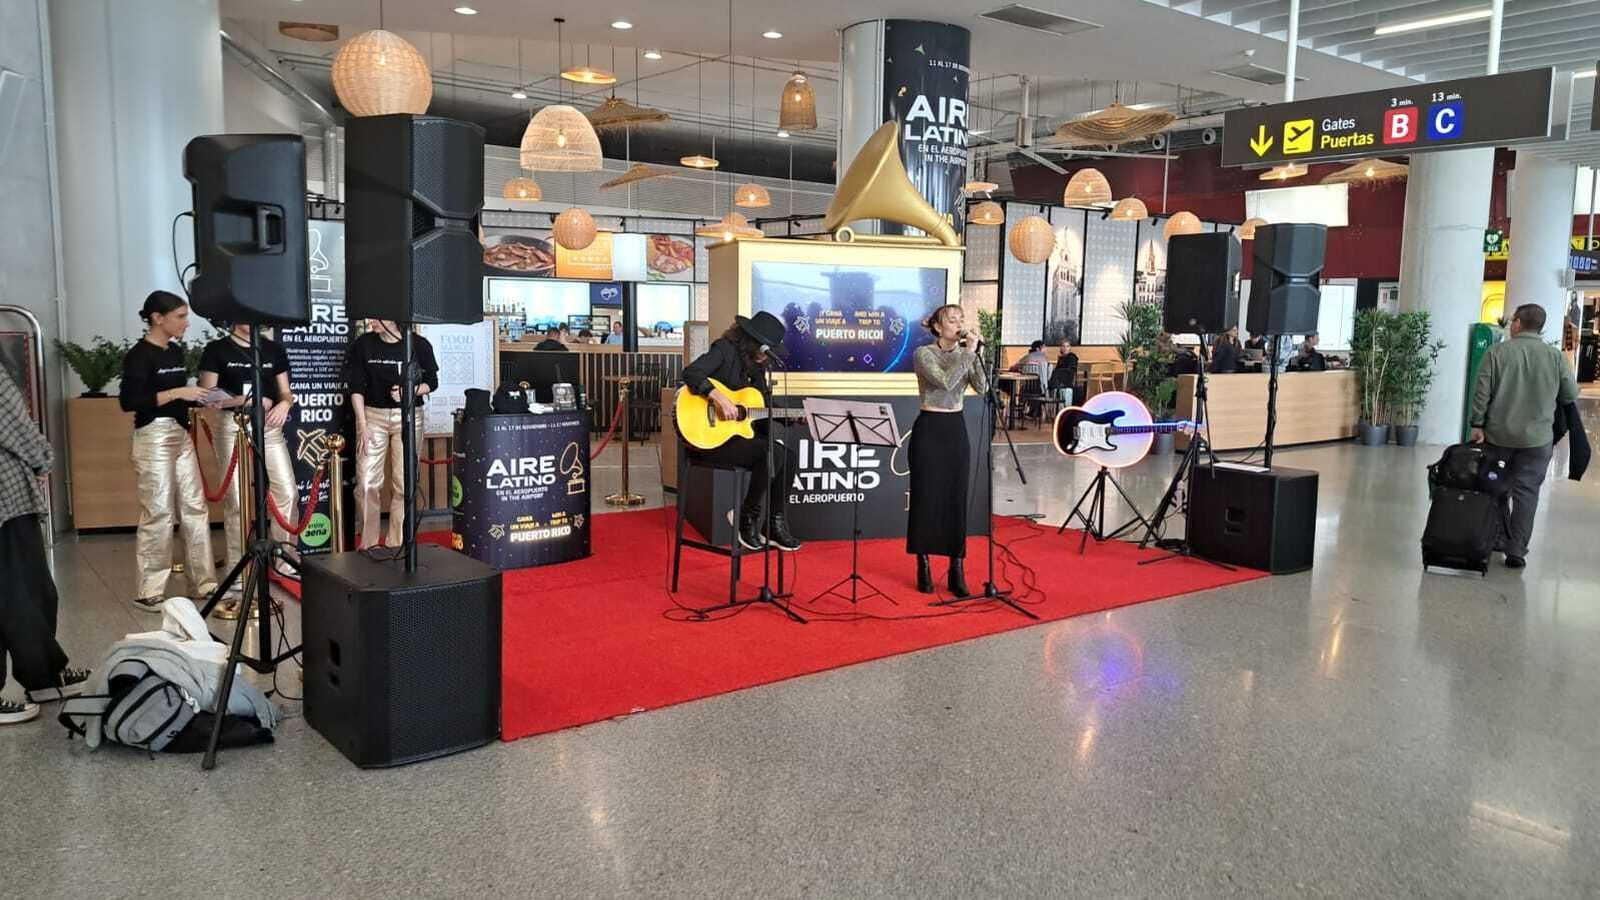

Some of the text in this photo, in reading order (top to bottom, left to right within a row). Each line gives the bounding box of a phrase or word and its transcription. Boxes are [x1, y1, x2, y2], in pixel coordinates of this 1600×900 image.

[1391, 98, 1397, 107] 3
[1432, 92, 1462, 103] 13 min.
[906, 94, 968, 128] AIR
[1322, 117, 1355, 132] Gates
[1391, 113, 1409, 139] B
[1435, 108, 1455, 134] C
[905, 124, 968, 146] LATIN
[1321, 132, 1375, 149] Puertas
[918, 143, 928, 153] EN
[931, 144, 940, 154] EL
[924, 153, 933, 163] IN
[935, 154, 949, 163] THE
[312, 304, 349, 322] RE
[282, 334, 348, 343] EN EL AEROPUERTO
[440, 334, 474, 345] FOOD
[816, 328, 884, 340] PUERTO RICO!
[290, 382, 310, 390] GANA
[324, 382, 341, 390] VIAJE
[301, 409, 332, 423] RICO
[799, 439, 880, 469] IRE
[487, 455, 556, 477] AIRE
[486, 474, 556, 489] LATINO
[792, 470, 881, 490] ATINO
[514, 486, 548, 495] AEROPUERTO
[789, 493, 865, 504] EL AEROPUERTO
[305, 528, 327, 537] aena
[510, 525, 571, 543] PUERTO RICO
